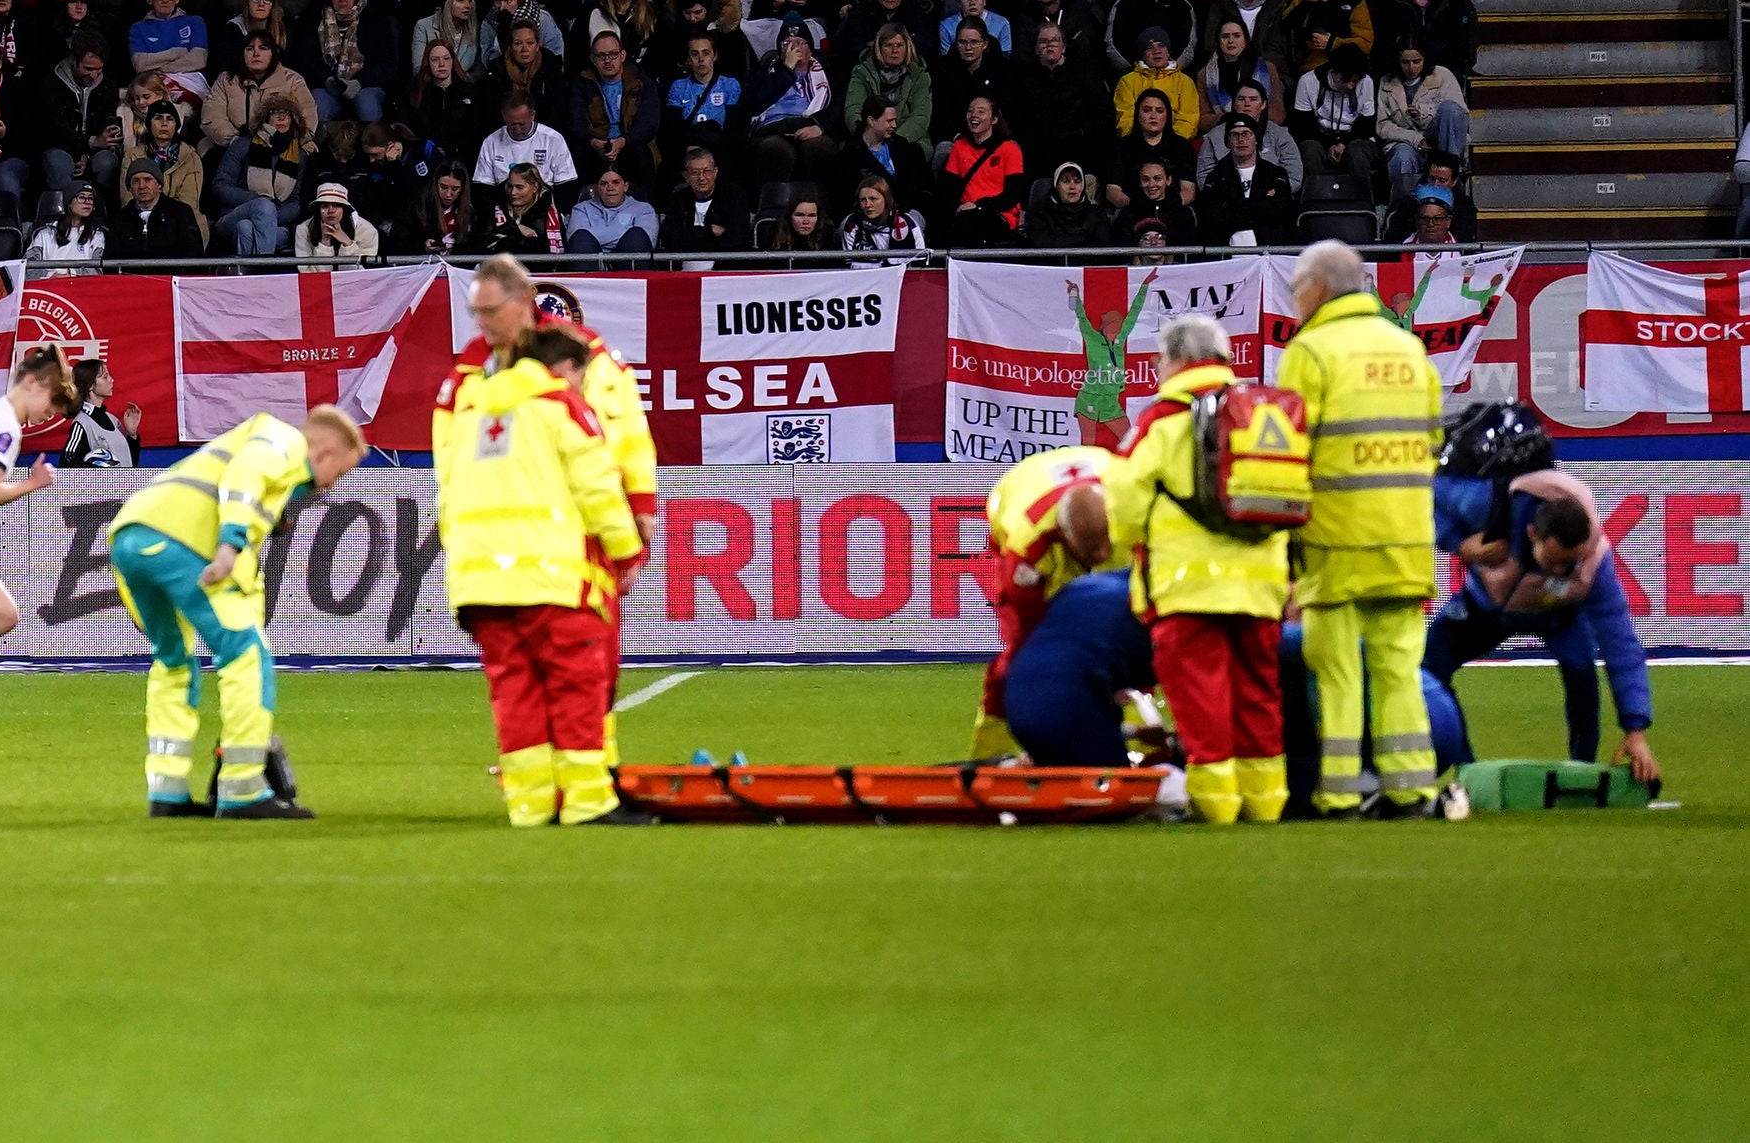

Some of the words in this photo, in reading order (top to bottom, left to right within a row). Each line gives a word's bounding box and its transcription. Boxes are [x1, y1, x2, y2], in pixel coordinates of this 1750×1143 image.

[29, 298, 82, 338] BELGIAN
[716, 293, 882, 336] LIONESSES
[283, 347, 339, 362] BRONZE
[347, 345, 356, 359] 2
[951, 346, 978, 371] be
[984, 358, 1160, 389] unapologetically
[1365, 362, 1416, 385] RED
[961, 397, 1001, 427] UP
[1006, 405, 1070, 436] THE
